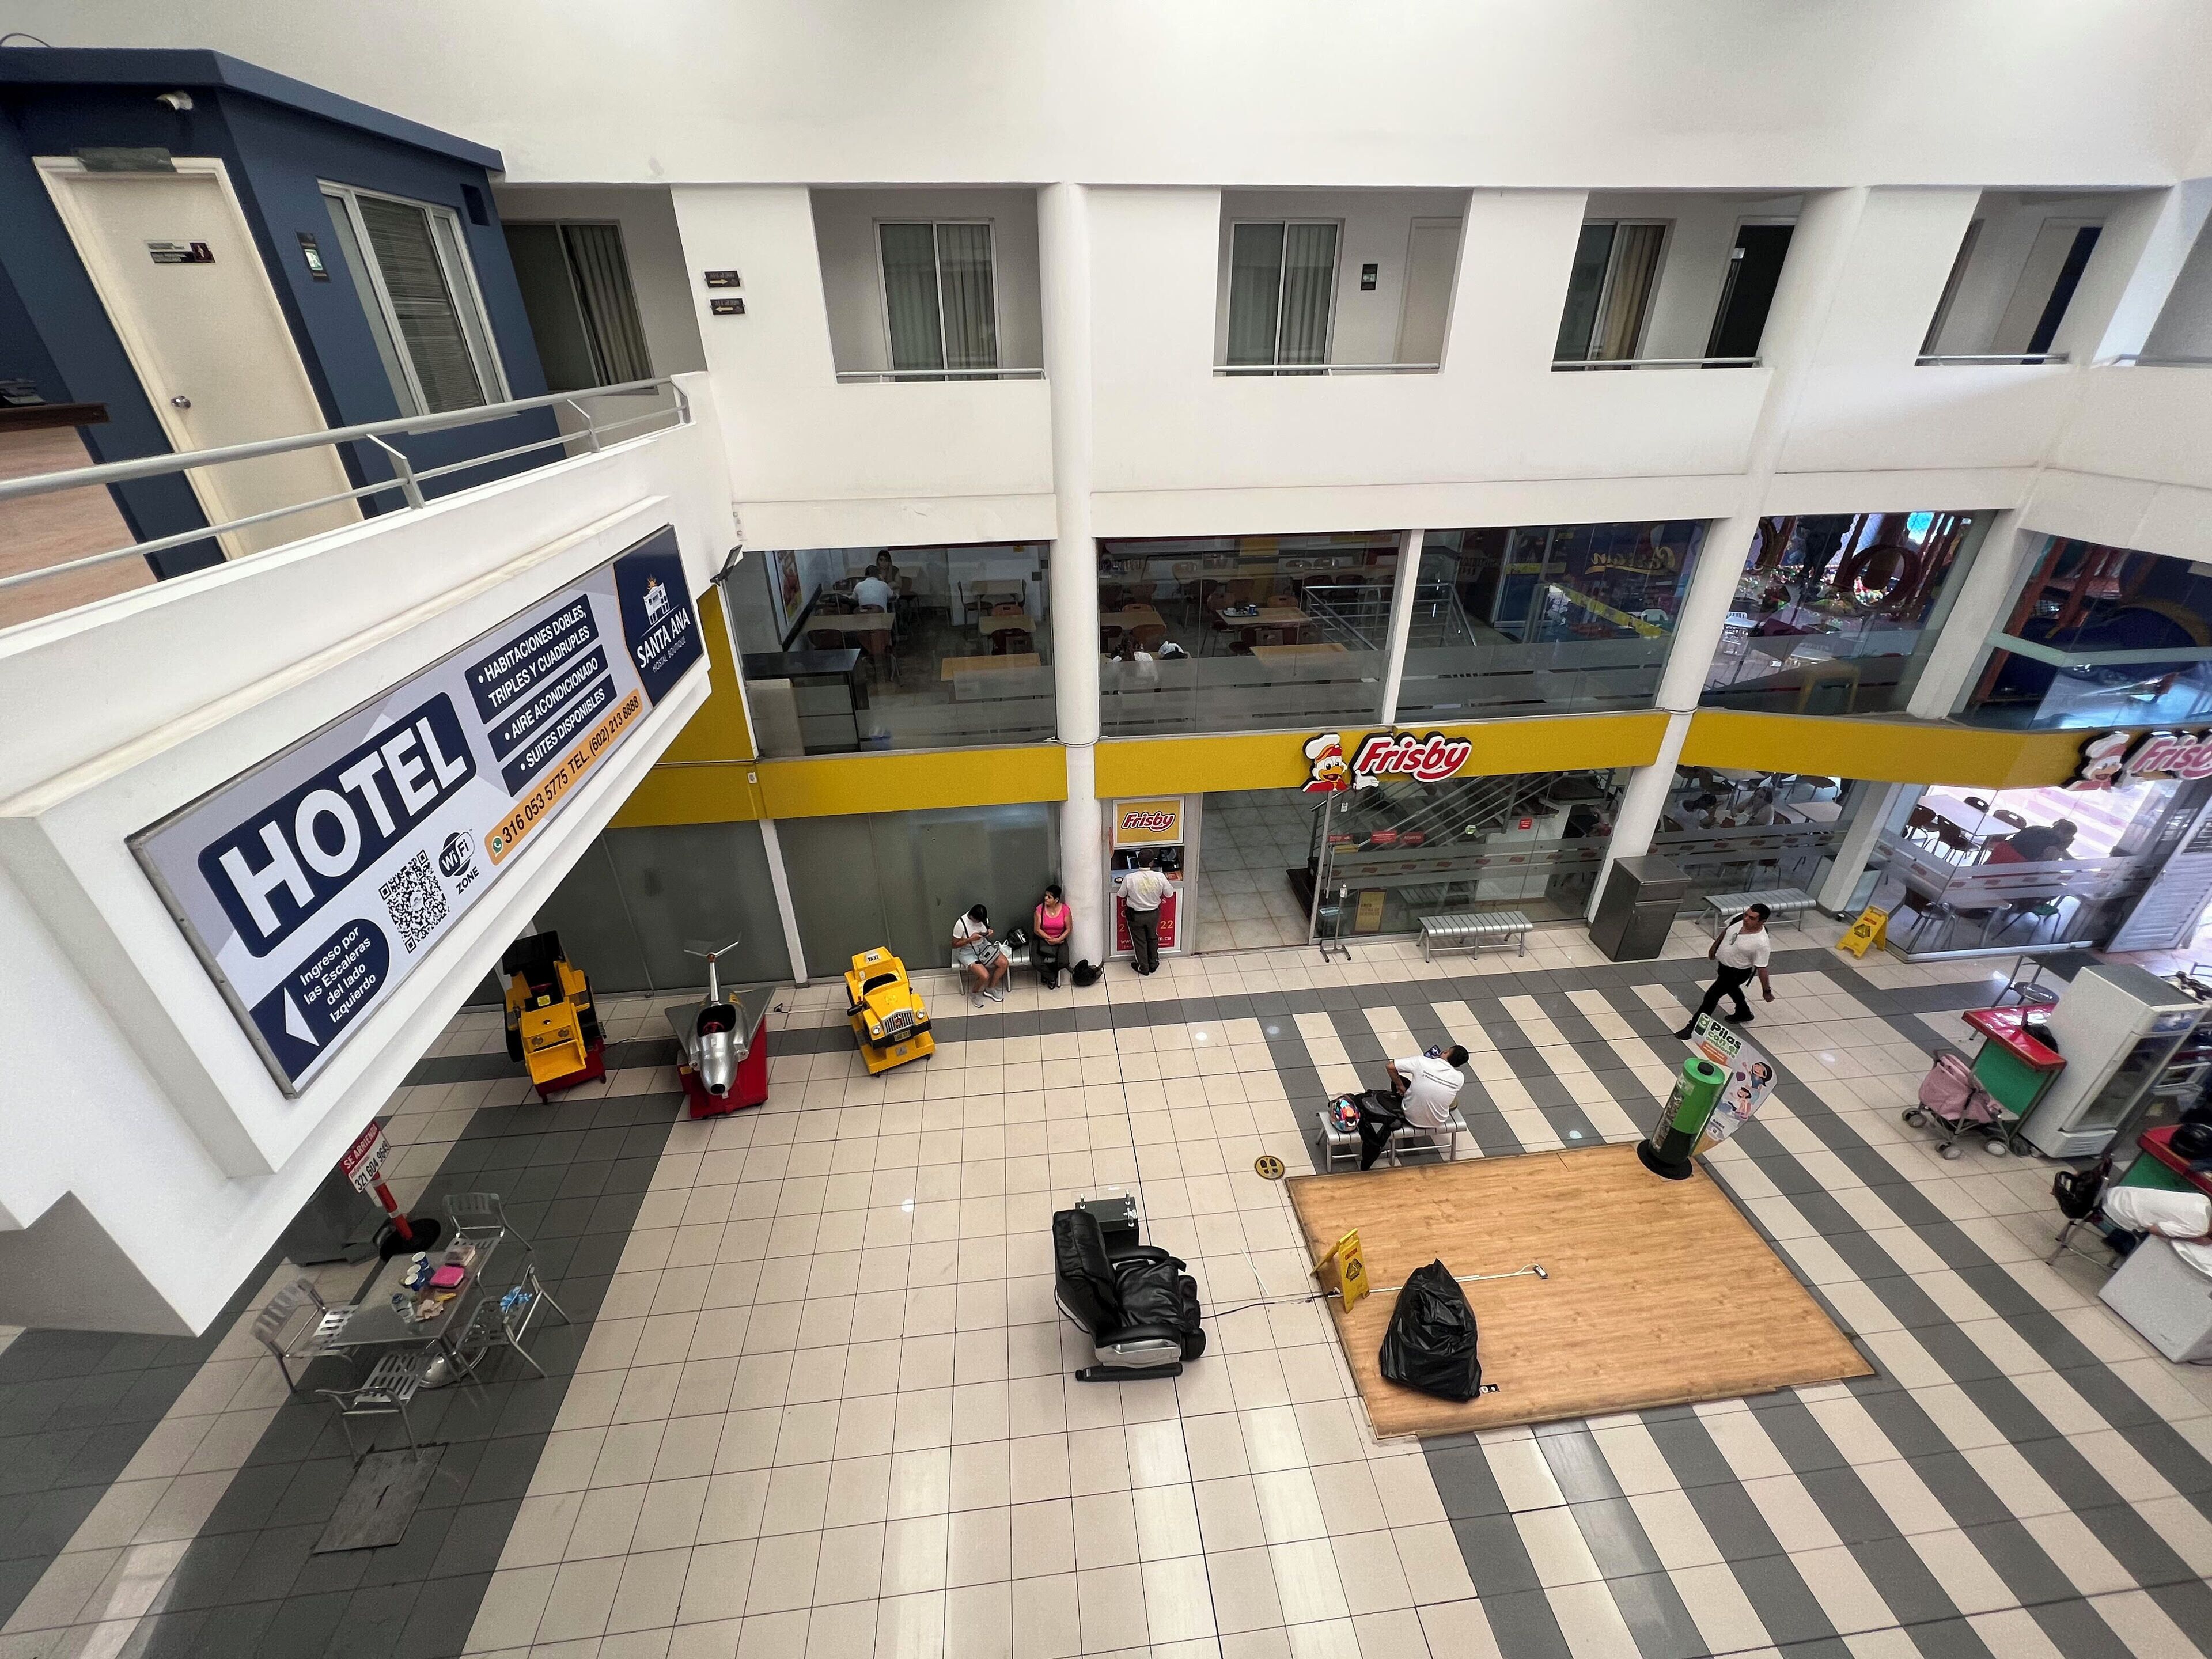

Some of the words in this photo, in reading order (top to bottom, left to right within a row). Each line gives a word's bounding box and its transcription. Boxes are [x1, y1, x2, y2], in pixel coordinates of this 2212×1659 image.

[484, 626, 553, 683] HABITACIONES
[552, 604, 587, 635] DOBLES,
[637, 625, 671, 668] SANTA
[671, 608, 691, 639] ANA
[488, 669, 531, 708] TRIPLES
[529, 664, 537, 678] Y
[536, 625, 590, 672] CUADRUPLES
[511, 709, 535, 739] AIRE
[535, 657, 599, 718] ACONDICIONADO
[526, 732, 558, 768] SUITES
[558, 688, 605, 740] DISPONIBLES
[502, 814, 525, 844] 316
[524, 793, 545, 821] 053
[544, 769, 569, 801] 5775
[567, 750, 590, 774] TEL.
[589, 726, 610, 757] (602)
[609, 713, 623, 734] 213
[623, 696, 639, 719] 8888
[1356, 737, 1471, 782] Frisby
[219, 717, 467, 938] HOTEL
[1122, 812, 1175, 831] Frisby
[456, 866, 479, 895] ZONE
[299, 945, 341, 986] Ingreso
[341, 926, 359, 947] por
[303, 986, 323, 1005] las
[321, 938, 372, 987] Escaleras
[326, 983, 343, 1005] del
[342, 964, 366, 988] lado
[329, 974, 376, 1023] Izquierdo
[1706, 1037, 1736, 1059] ambiente
[1708, 1031, 1726, 1046] con
[1729, 1046, 1740, 1055] el
[1710, 1021, 1742, 1049] Pilas
[344, 1154, 355, 1169] SE
[354, 1172, 369, 1190] 321
[365, 1157, 379, 1177] 604
